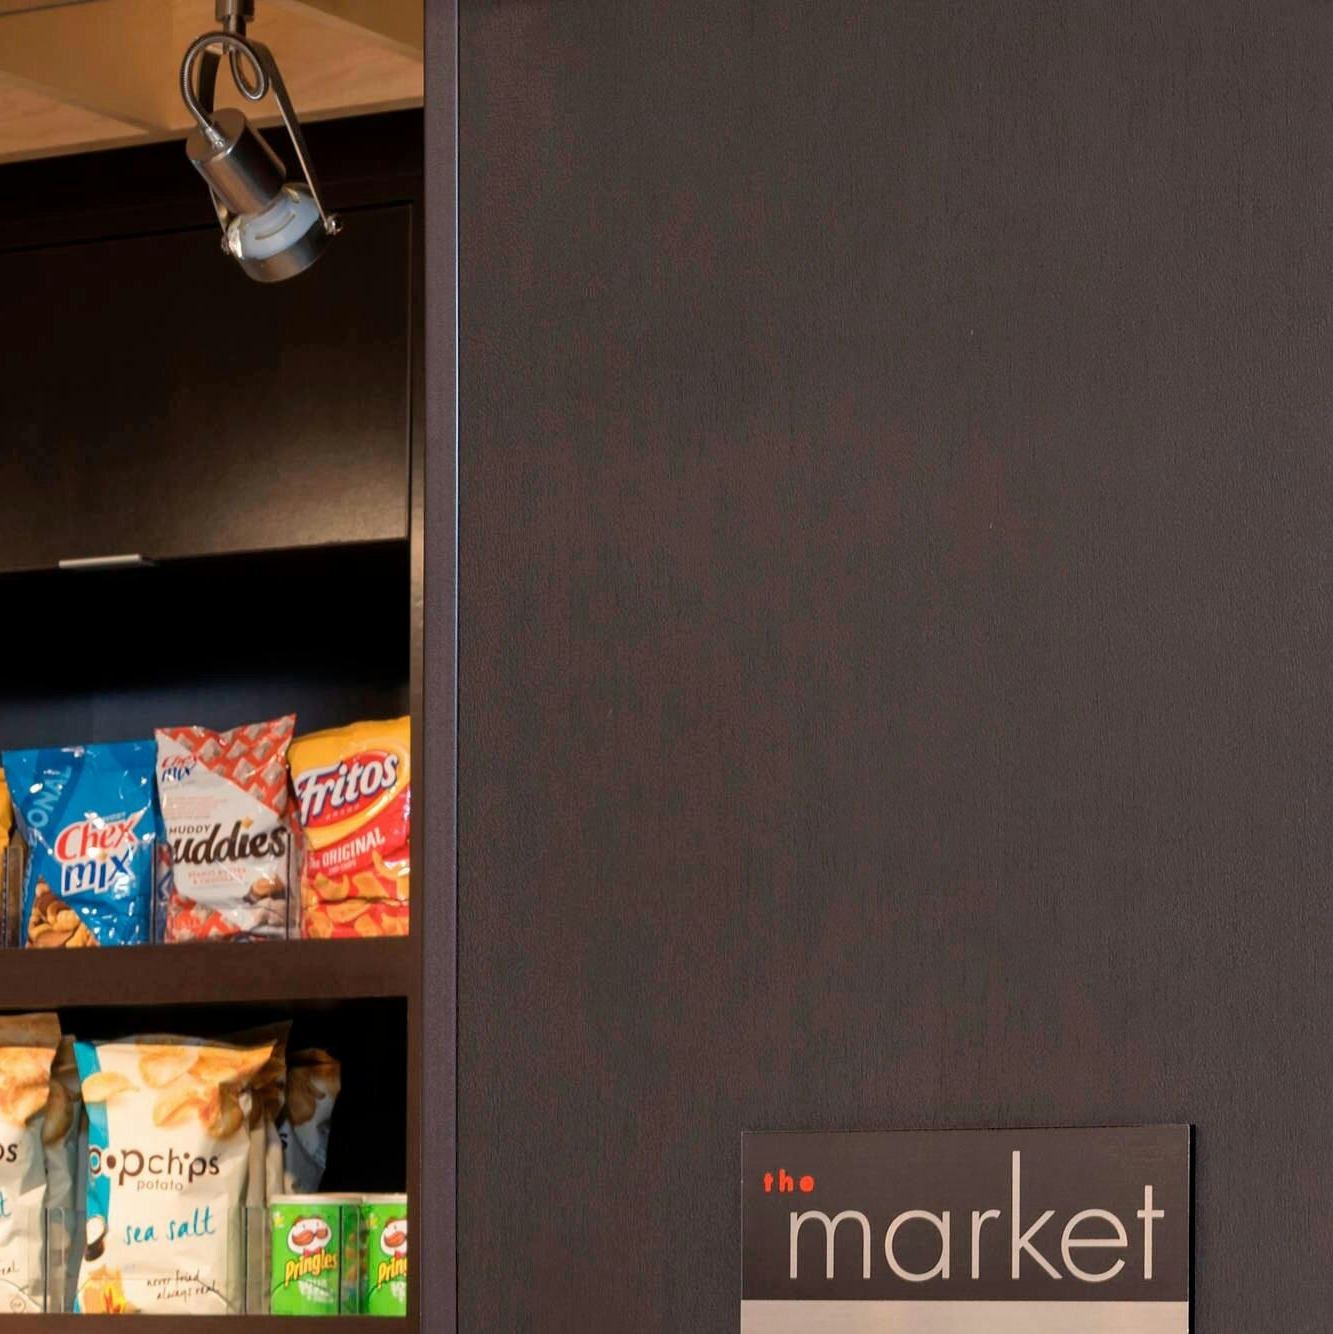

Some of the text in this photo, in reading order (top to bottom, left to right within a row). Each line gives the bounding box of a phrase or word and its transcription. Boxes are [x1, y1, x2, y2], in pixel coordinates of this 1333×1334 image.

[293, 753, 399, 827] Fritos
[56, 817, 136, 862] Chex
[169, 823, 211, 835] MUDDY
[171, 819, 288, 866] uddies
[322, 826, 387, 868] ORIGINAL
[136, 1178, 183, 1192] potato
[763, 1168, 815, 1194] the
[125, 1205, 215, 1246] sea salt
[789, 1150, 1165, 1283] market
[284, 1247, 337, 1289] Pringles
